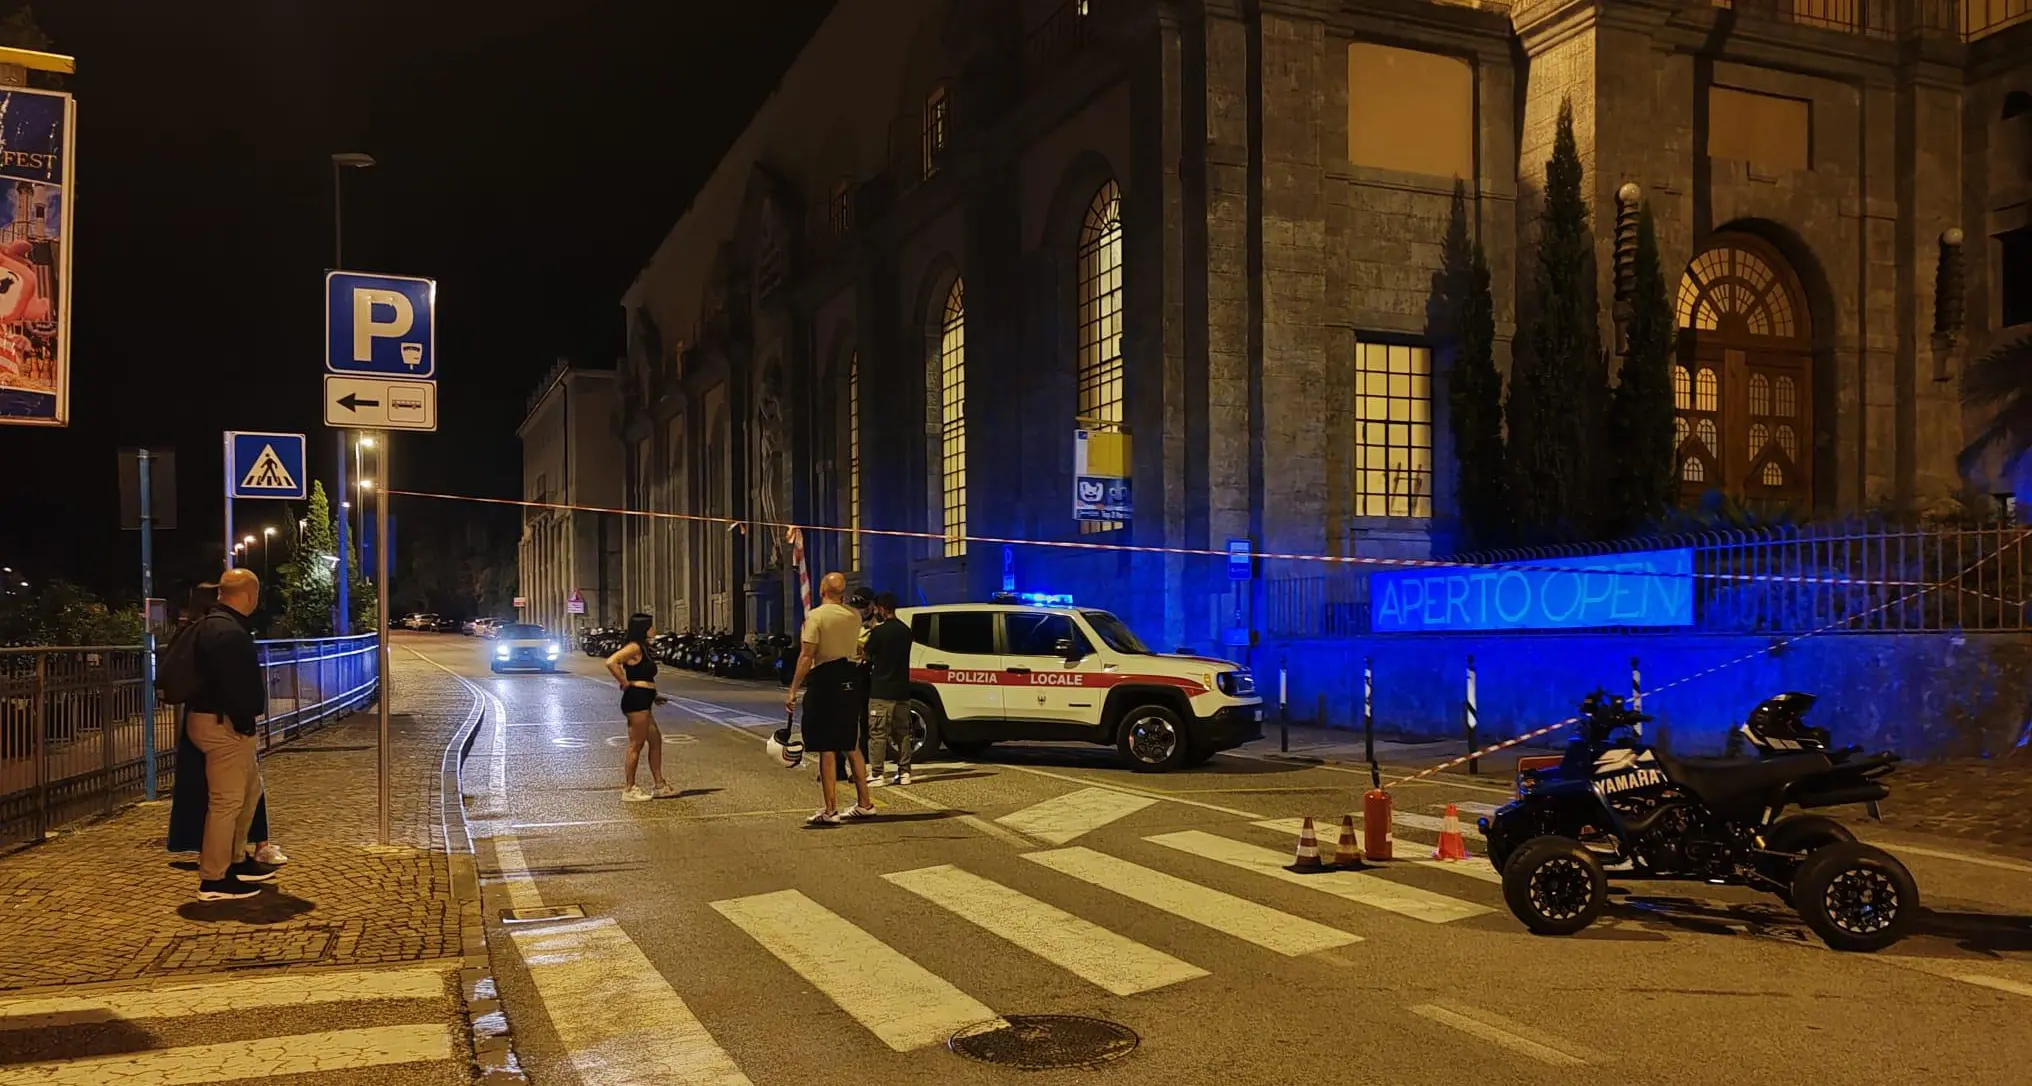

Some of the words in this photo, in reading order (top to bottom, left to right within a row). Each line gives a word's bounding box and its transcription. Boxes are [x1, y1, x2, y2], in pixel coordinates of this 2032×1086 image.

[2, 150, 58, 169] FEST
[353, 287, 414, 362] P
[1378, 570, 1531, 625] APERTO
[1540, 560, 1683, 621] OPEN
[947, 671, 998, 684] POLIZIA
[1030, 673, 1083, 685] LOCALE
[1594, 768, 1661, 795] YAMAHA
